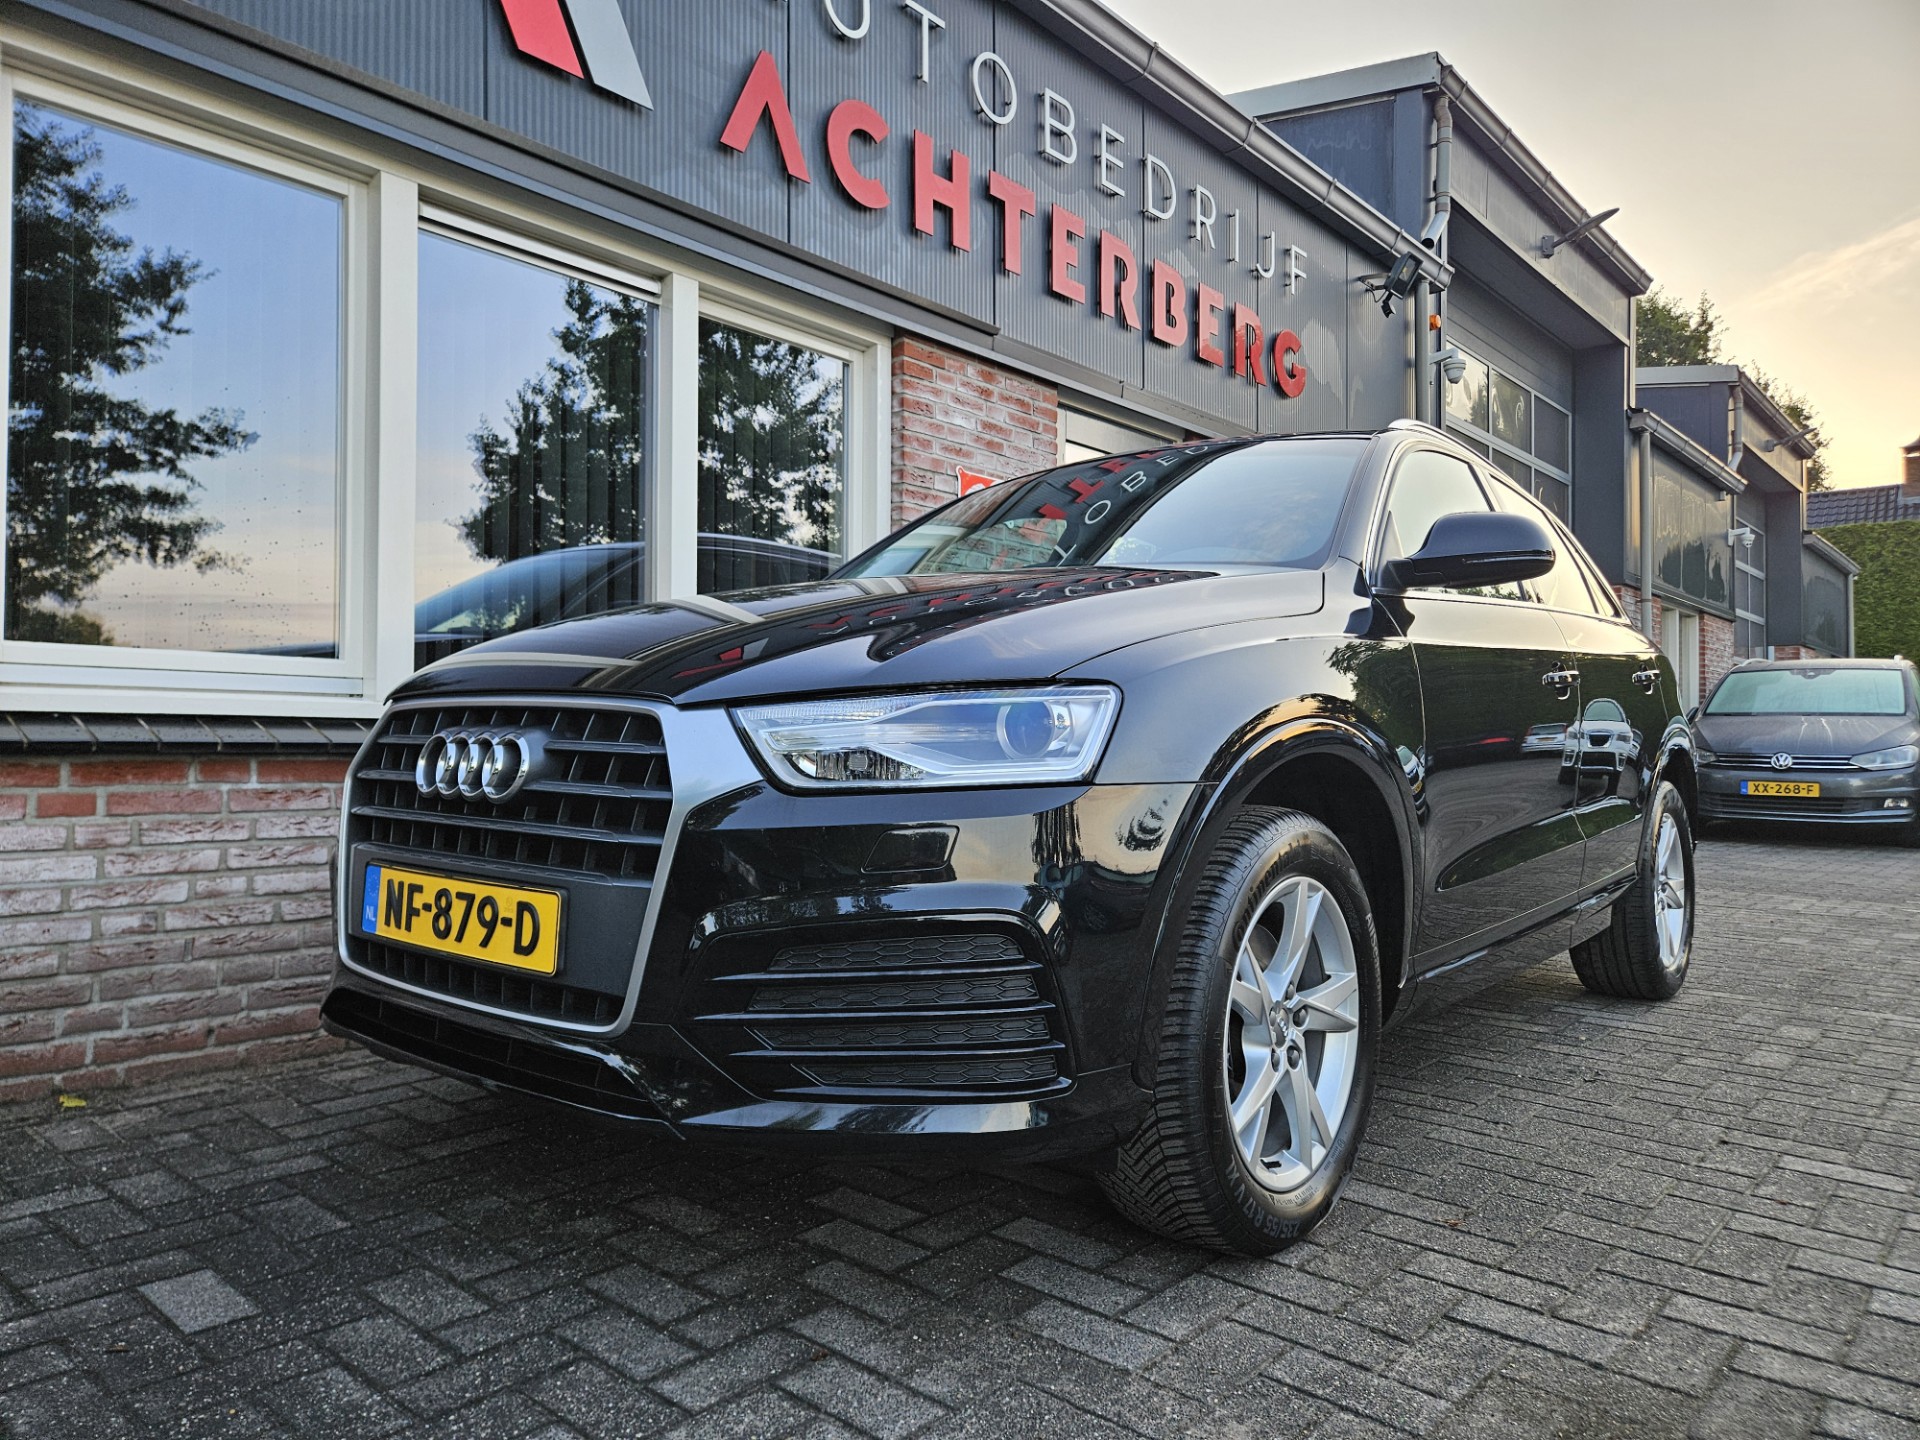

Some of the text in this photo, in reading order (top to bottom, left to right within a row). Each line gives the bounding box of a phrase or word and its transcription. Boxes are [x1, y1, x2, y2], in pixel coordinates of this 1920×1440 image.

[776, 0, 1307, 296] UTOBEDRIJF
[720, 49, 1307, 399] ACHTERBERG
[1753, 783, 1814, 795] XX-268-F
[365, 905, 376, 922] NL
[384, 878, 540, 957] NF-879-D
